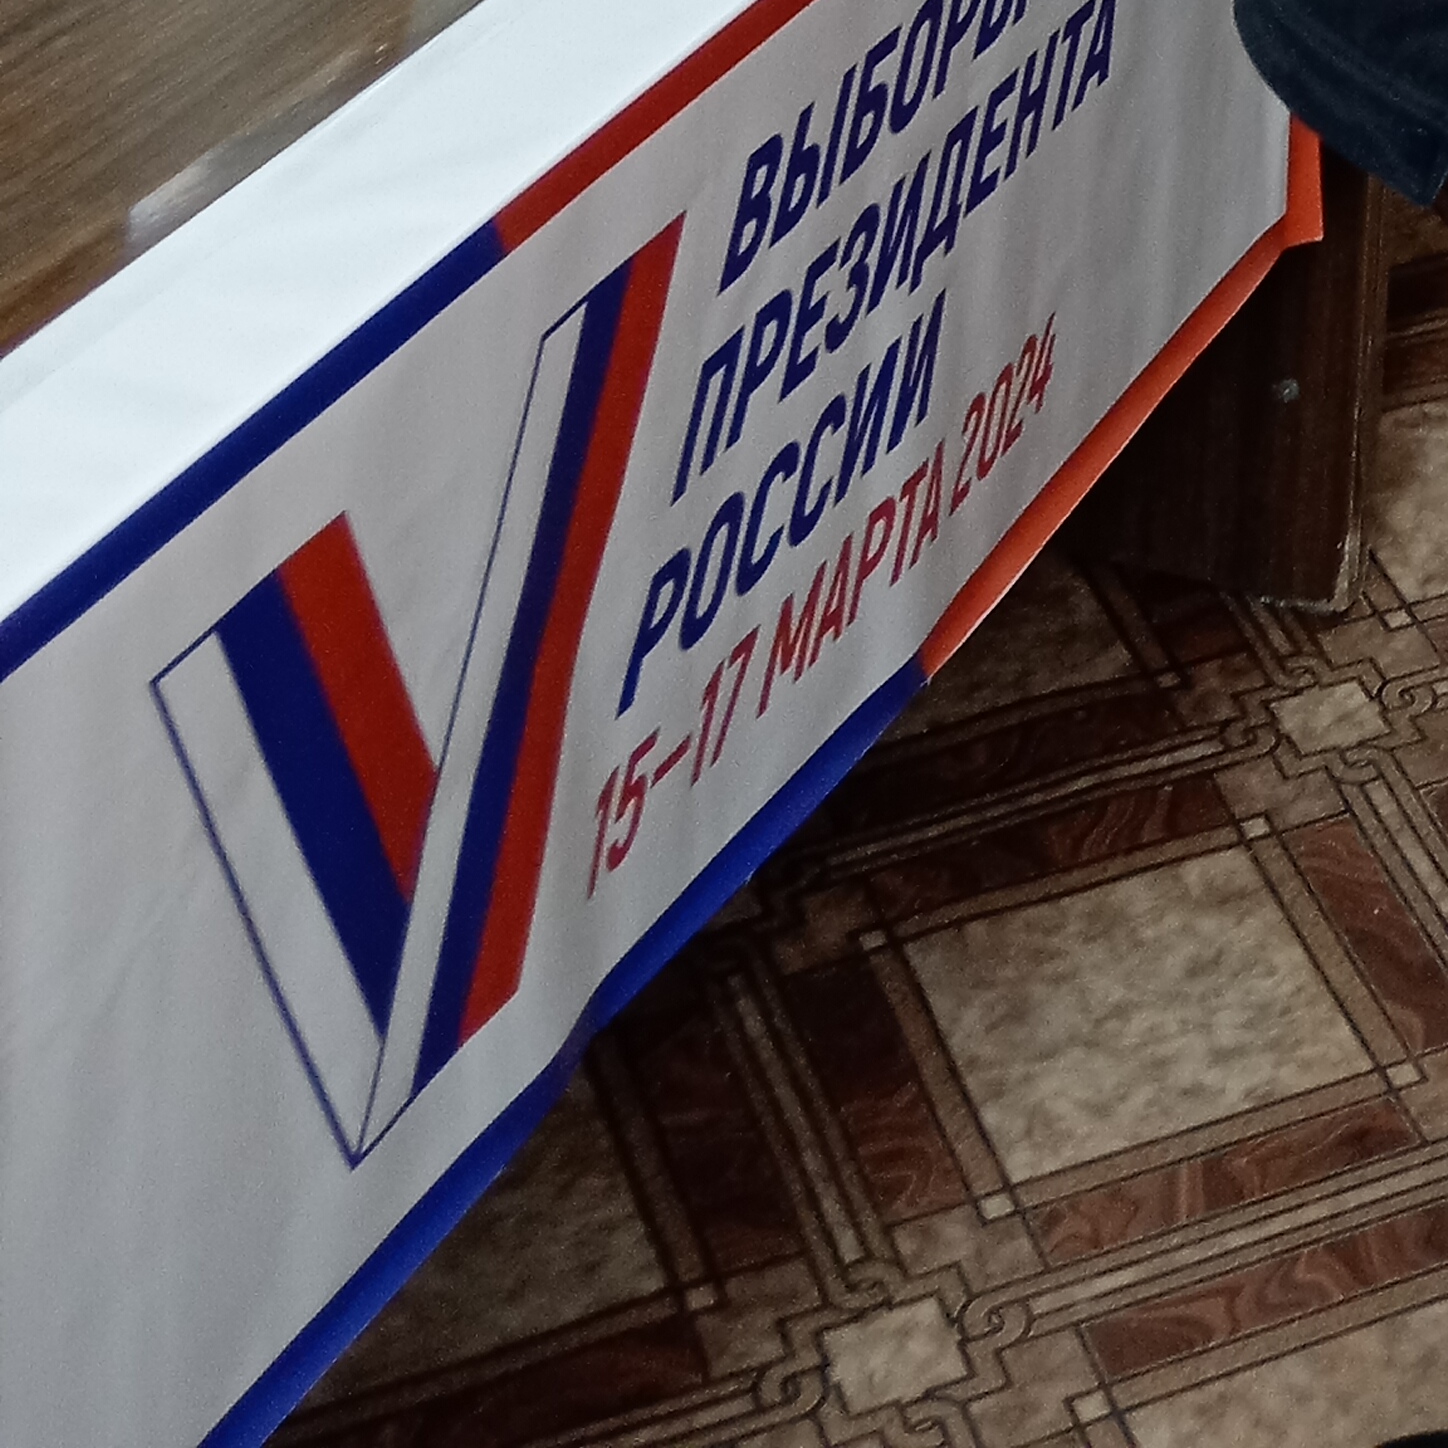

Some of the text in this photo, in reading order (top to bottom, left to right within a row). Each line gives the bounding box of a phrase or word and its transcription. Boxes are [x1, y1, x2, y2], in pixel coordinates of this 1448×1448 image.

[615, 288, 946, 720] РОССИИ
[756, 438, 945, 719] МАРТА
[947, 311, 1057, 517] 2024
